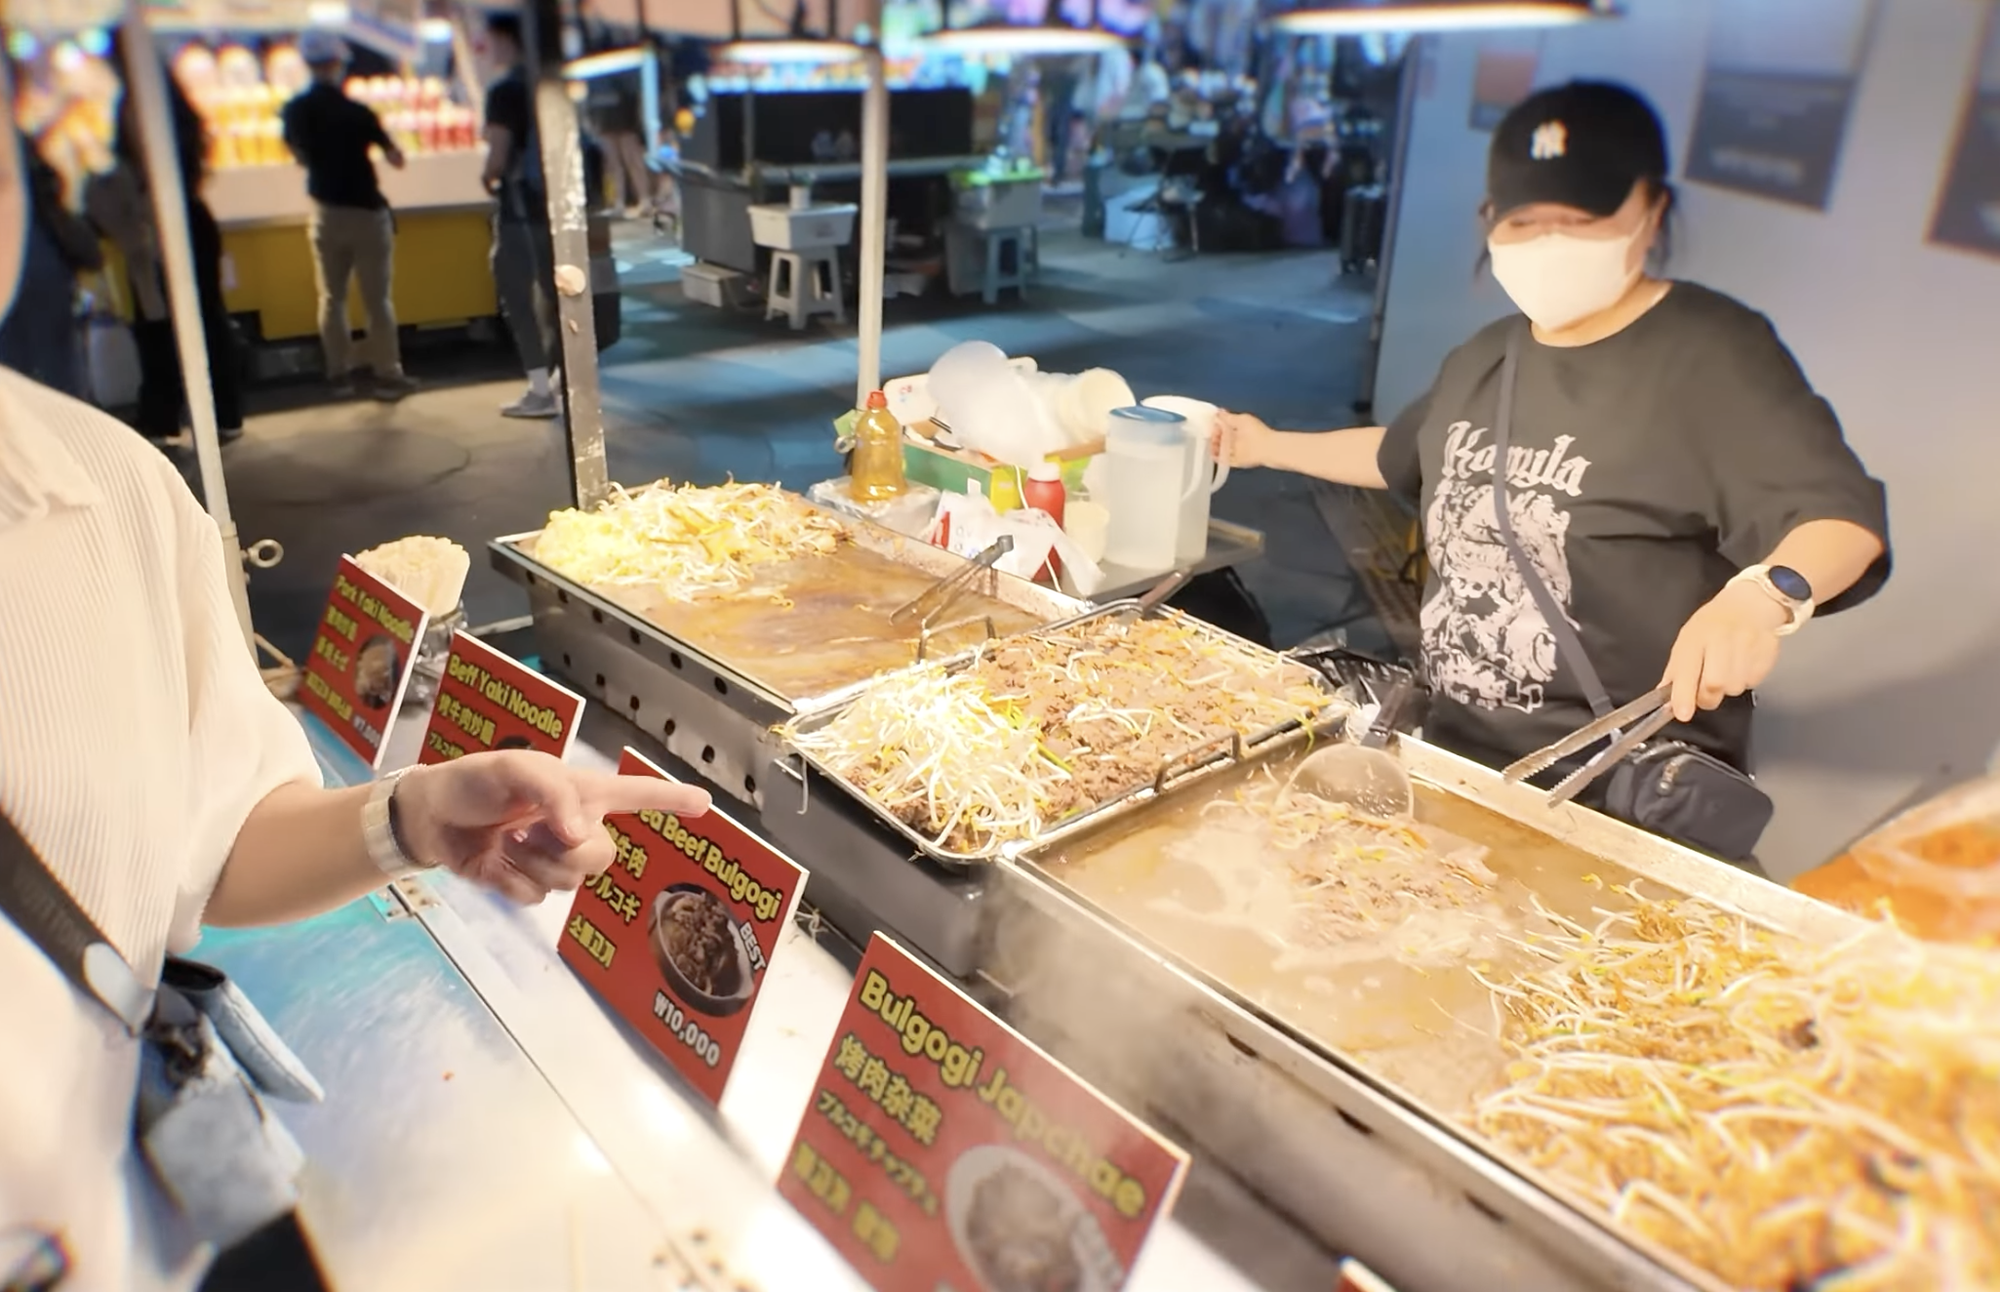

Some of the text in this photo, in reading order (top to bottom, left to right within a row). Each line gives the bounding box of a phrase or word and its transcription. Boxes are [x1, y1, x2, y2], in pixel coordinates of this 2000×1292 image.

[448, 654, 564, 739] Beff Yaki Noodle
[659, 813, 782, 920] Beef Bulgogi
[740, 922, 766, 970] BEST
[860, 970, 1144, 1218] Bulgogi Japchae
